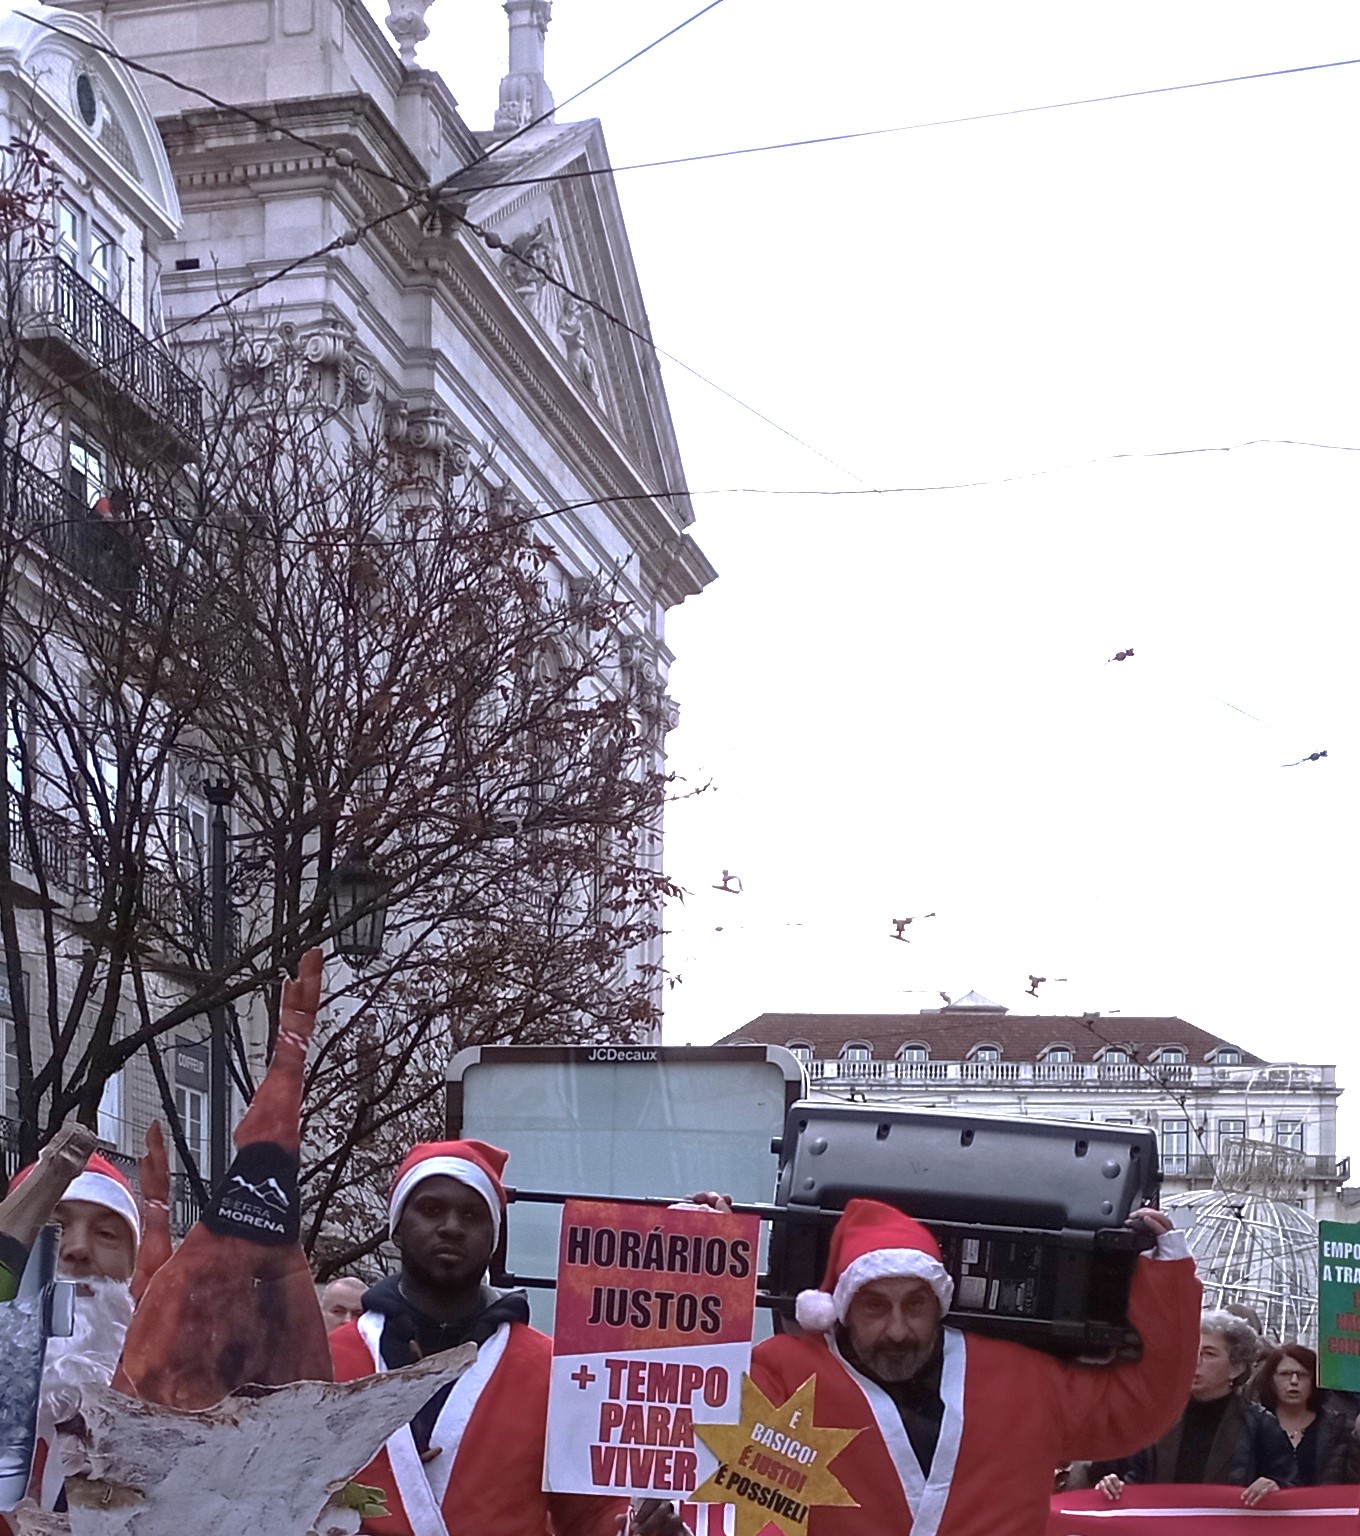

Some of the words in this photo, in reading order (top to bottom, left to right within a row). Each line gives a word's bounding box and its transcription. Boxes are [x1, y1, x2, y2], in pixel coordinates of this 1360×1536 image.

[588, 1048, 658, 1061] JCDecaux
[218, 1207, 286, 1234] MORENA
[566, 1224, 751, 1279] HORÁRIOS
[1322, 1264, 1333, 1282] A
[587, 1286, 723, 1336] JUSTOS
[604, 1358, 729, 1408] TEMPO
[598, 1402, 696, 1449] PARA
[788, 1408, 802, 1430] É
[750, 1422, 818, 1467] BÁSICO!
[589, 1445, 698, 1492] VIVER
[738, 1444, 754, 1467] É
[748, 1452, 808, 1494] JUSTO!
[714, 1463, 729, 1486] É
[725, 1471, 808, 1525] POSSÍVEL!
